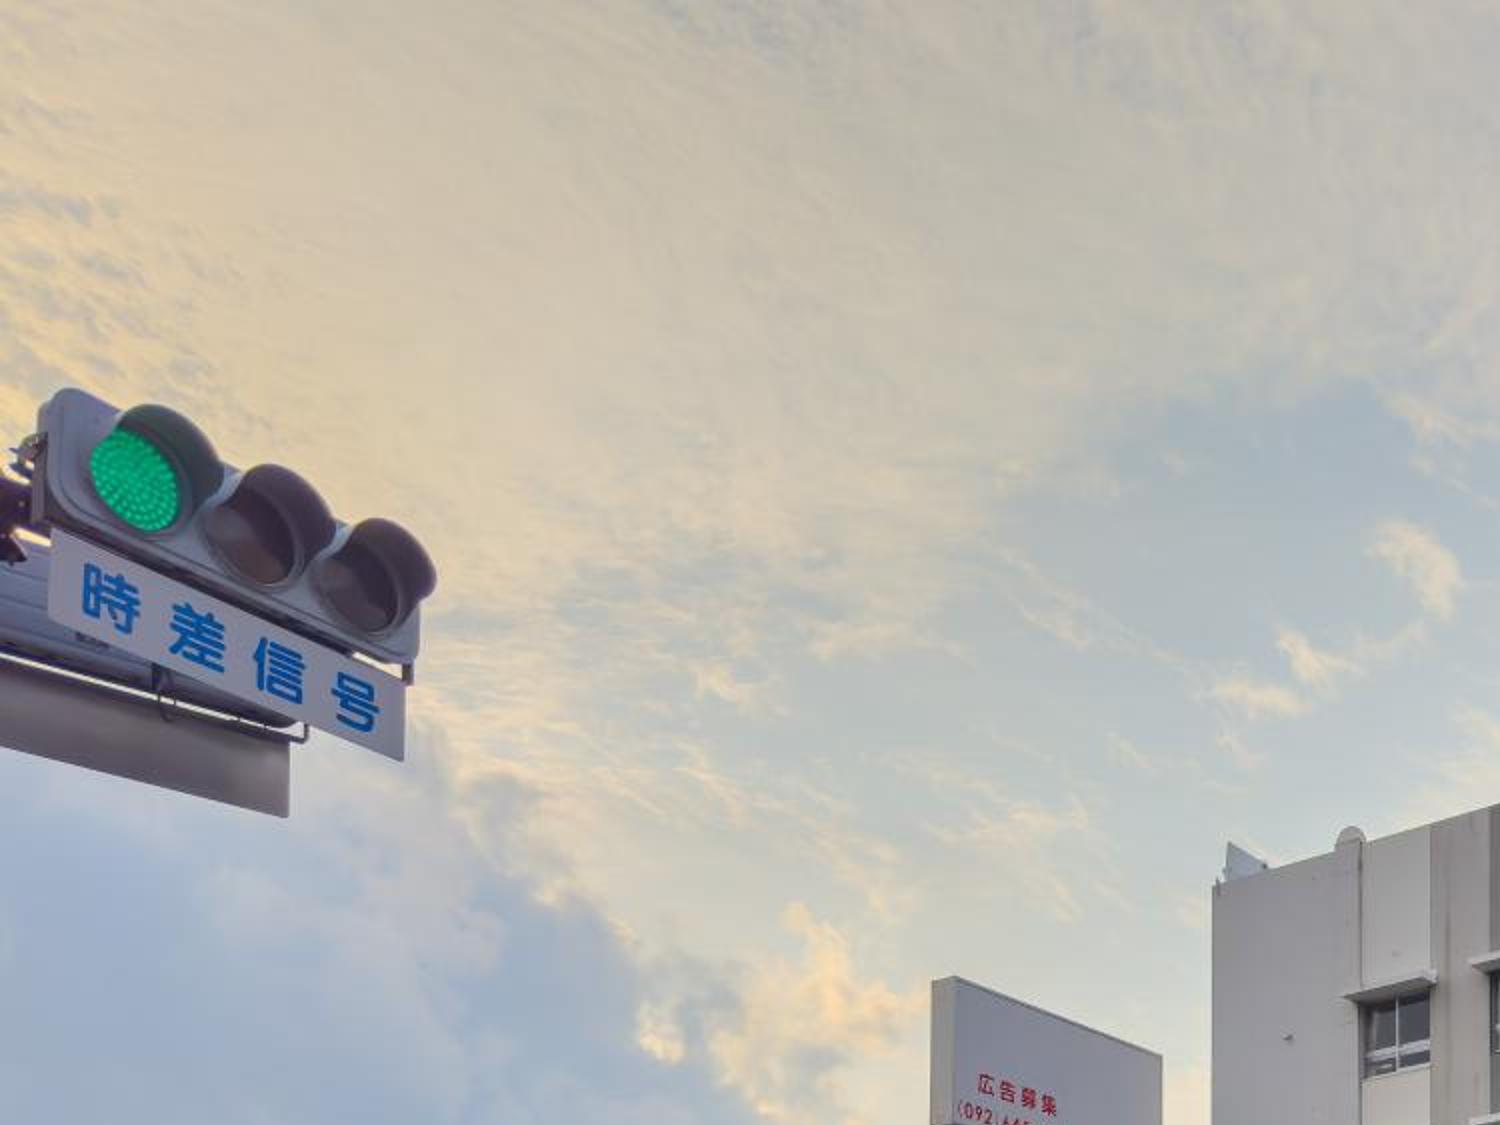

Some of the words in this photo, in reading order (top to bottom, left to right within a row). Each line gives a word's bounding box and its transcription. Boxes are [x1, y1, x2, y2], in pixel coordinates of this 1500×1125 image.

[81, 562, 380, 733] 時差信号
[977, 1073, 1057, 1117] 広告募集
